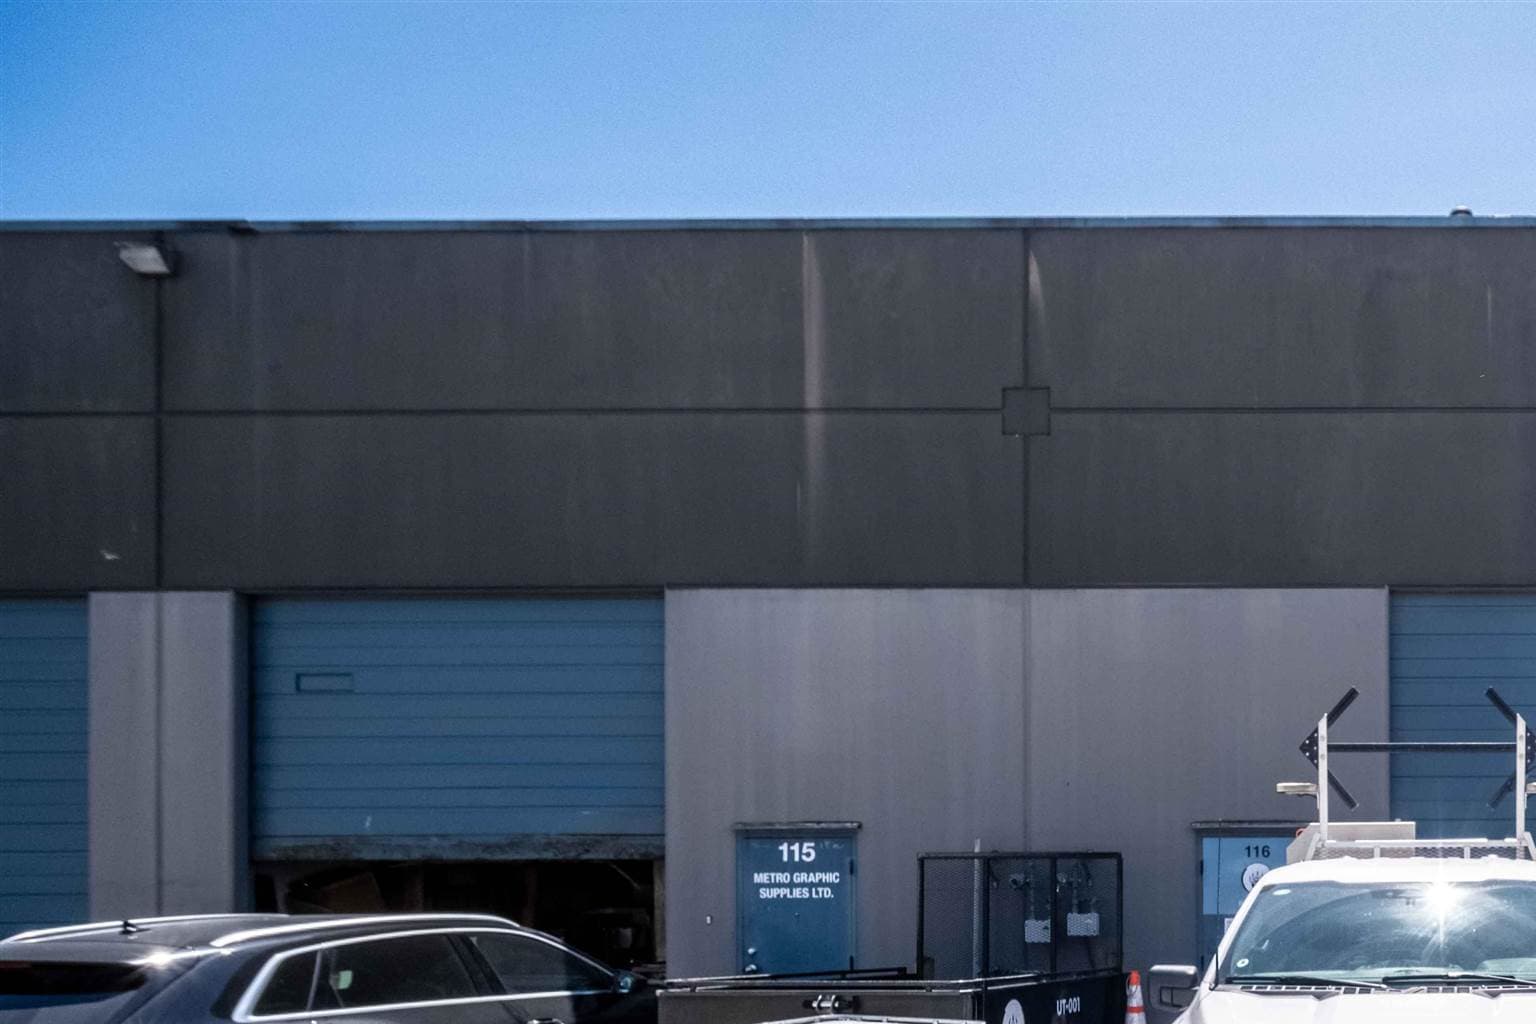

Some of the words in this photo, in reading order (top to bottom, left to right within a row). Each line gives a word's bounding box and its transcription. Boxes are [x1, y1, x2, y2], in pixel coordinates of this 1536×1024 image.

[778, 842, 816, 862] 115
[1245, 845, 1271, 858] 116
[753, 872, 790, 883] METRO
[793, 872, 840, 883] GRAPHIC
[759, 887, 809, 899] SUPPLIES
[812, 887, 834, 898] LTD.
[1056, 996, 1080, 1016] UT-001
